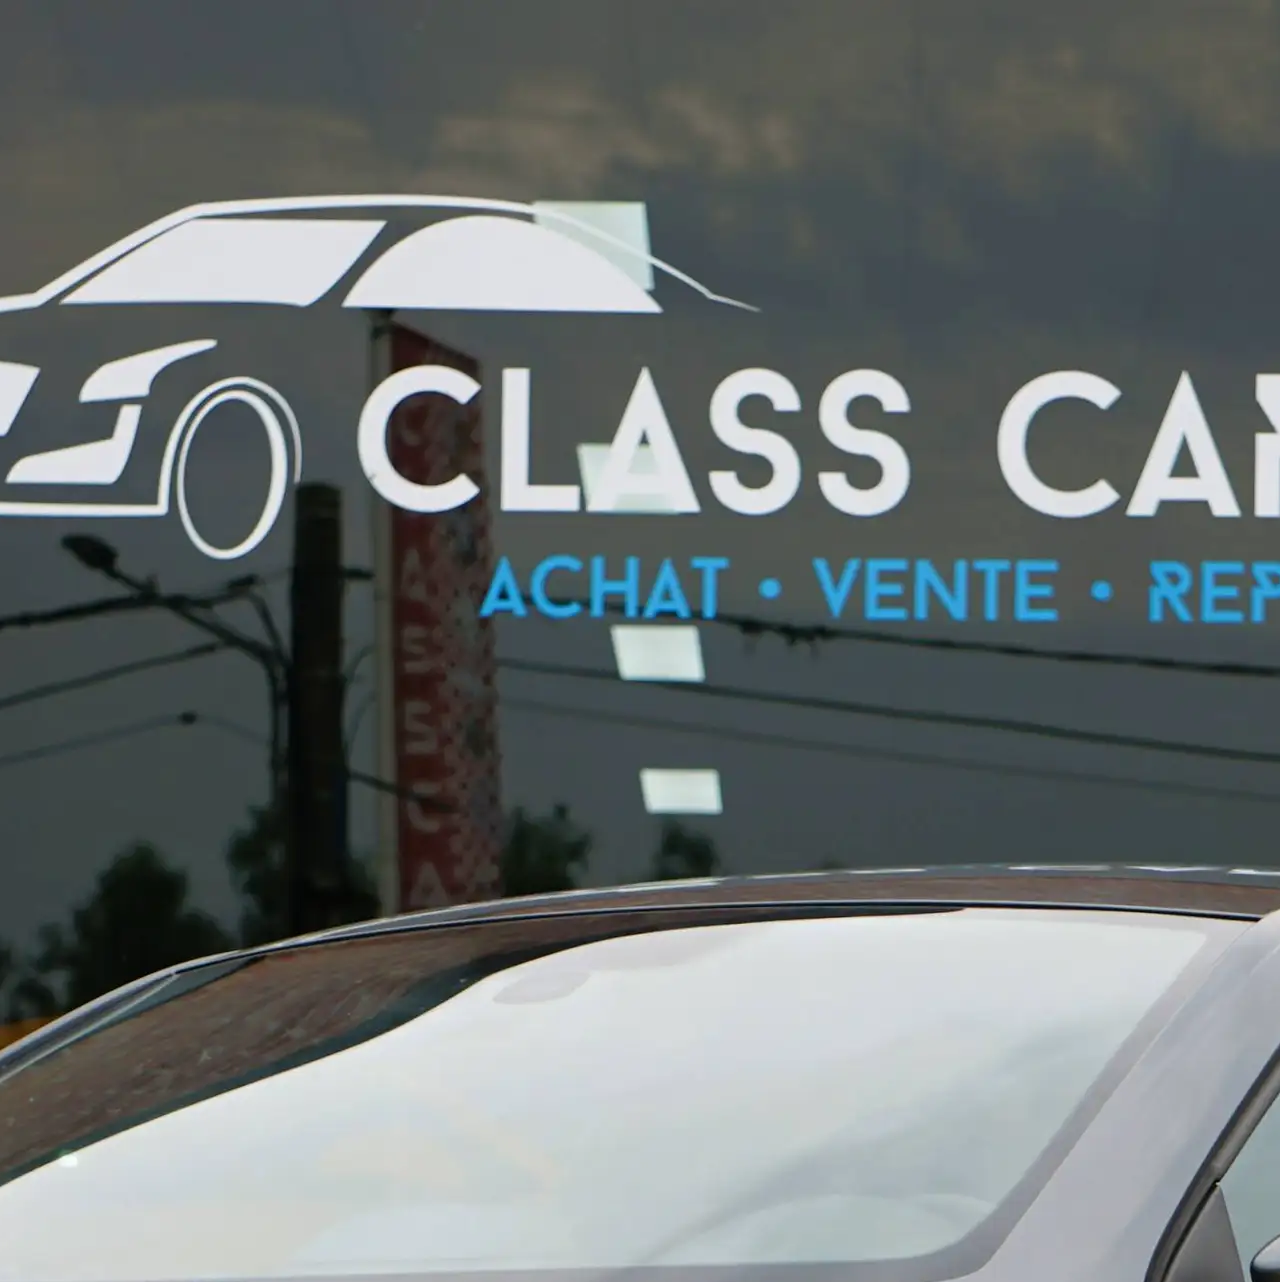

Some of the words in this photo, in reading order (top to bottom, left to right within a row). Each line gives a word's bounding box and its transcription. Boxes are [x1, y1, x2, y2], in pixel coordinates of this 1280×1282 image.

[358, 365, 910, 516] CLASS
[479, 554, 730, 621] ACHAT
[812, 557, 1061, 623] VENTE
